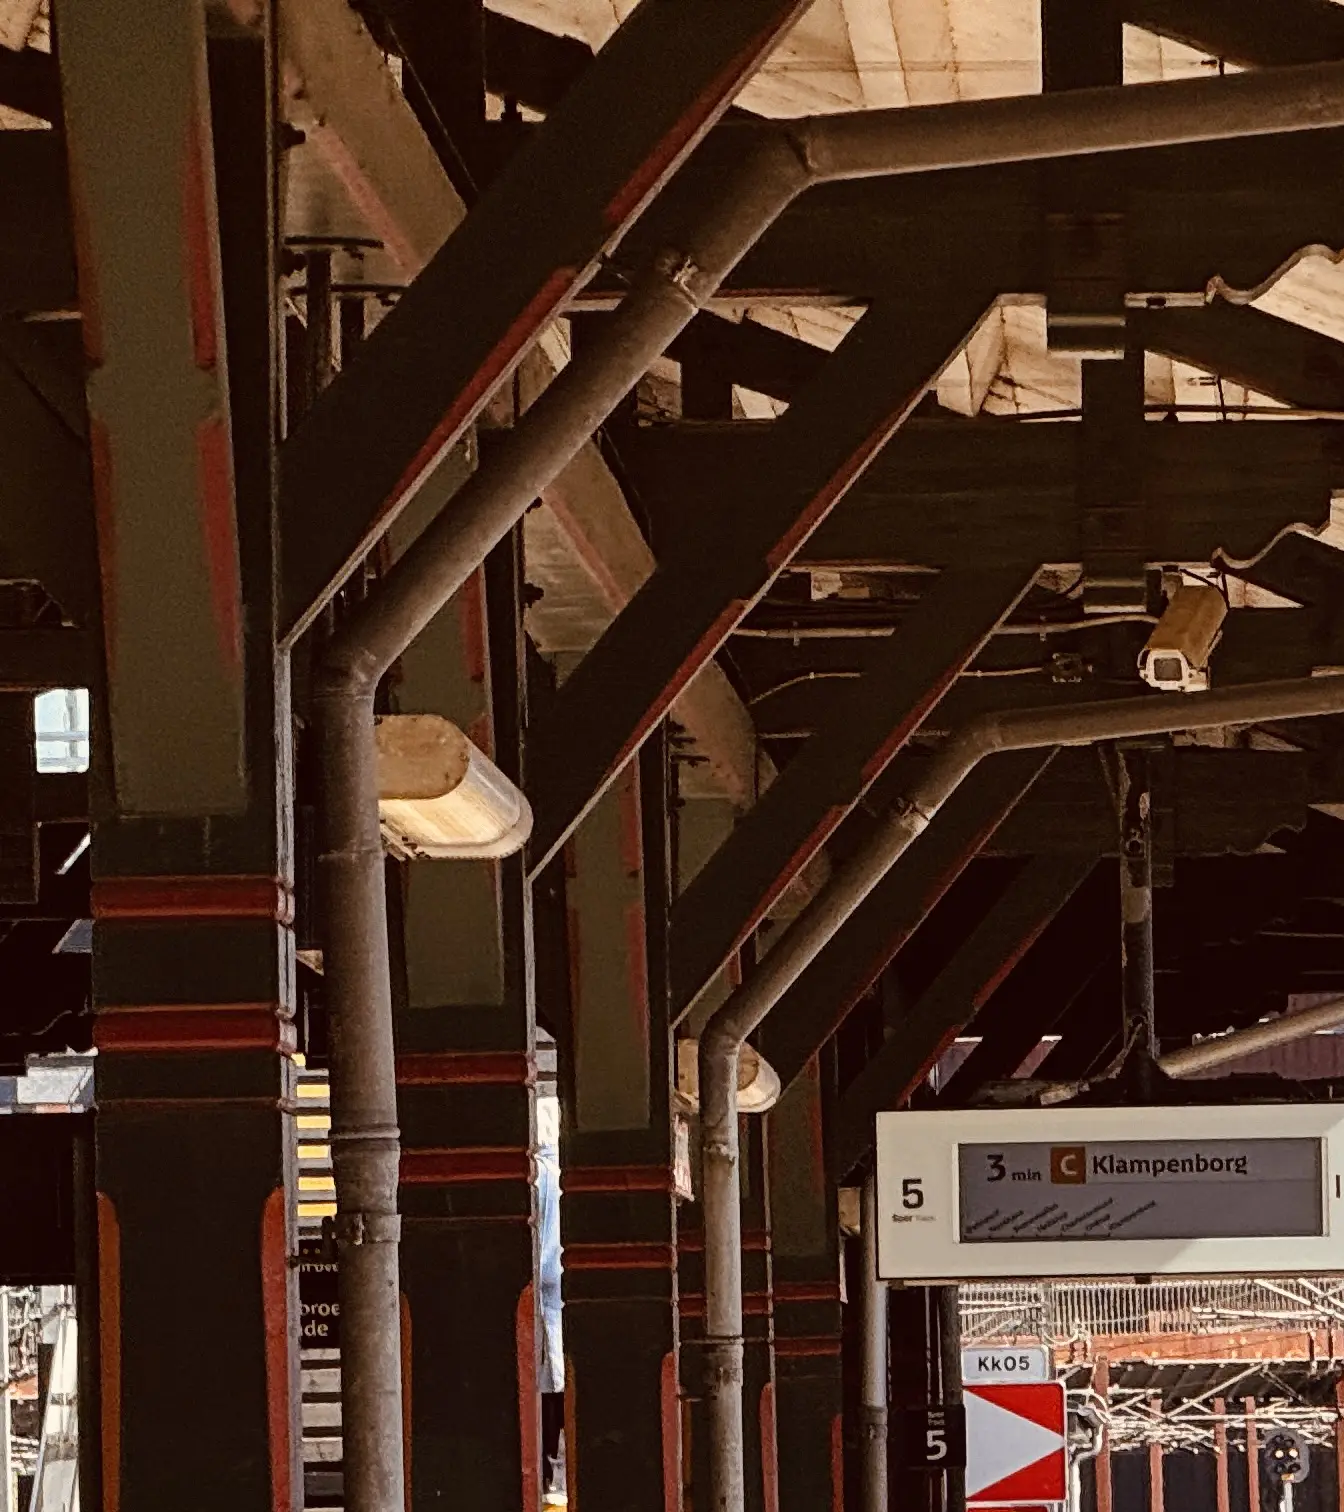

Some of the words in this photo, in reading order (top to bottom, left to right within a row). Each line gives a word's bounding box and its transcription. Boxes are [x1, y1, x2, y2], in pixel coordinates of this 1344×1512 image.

[987, 1154, 1006, 1182] 3
[1012, 1170, 1041, 1182] min
[1061, 1154, 1076, 1175] C
[1093, 1152, 1248, 1177] Klampenborg
[902, 1178, 924, 1209] 5
[926, 1429, 948, 1461] 5
